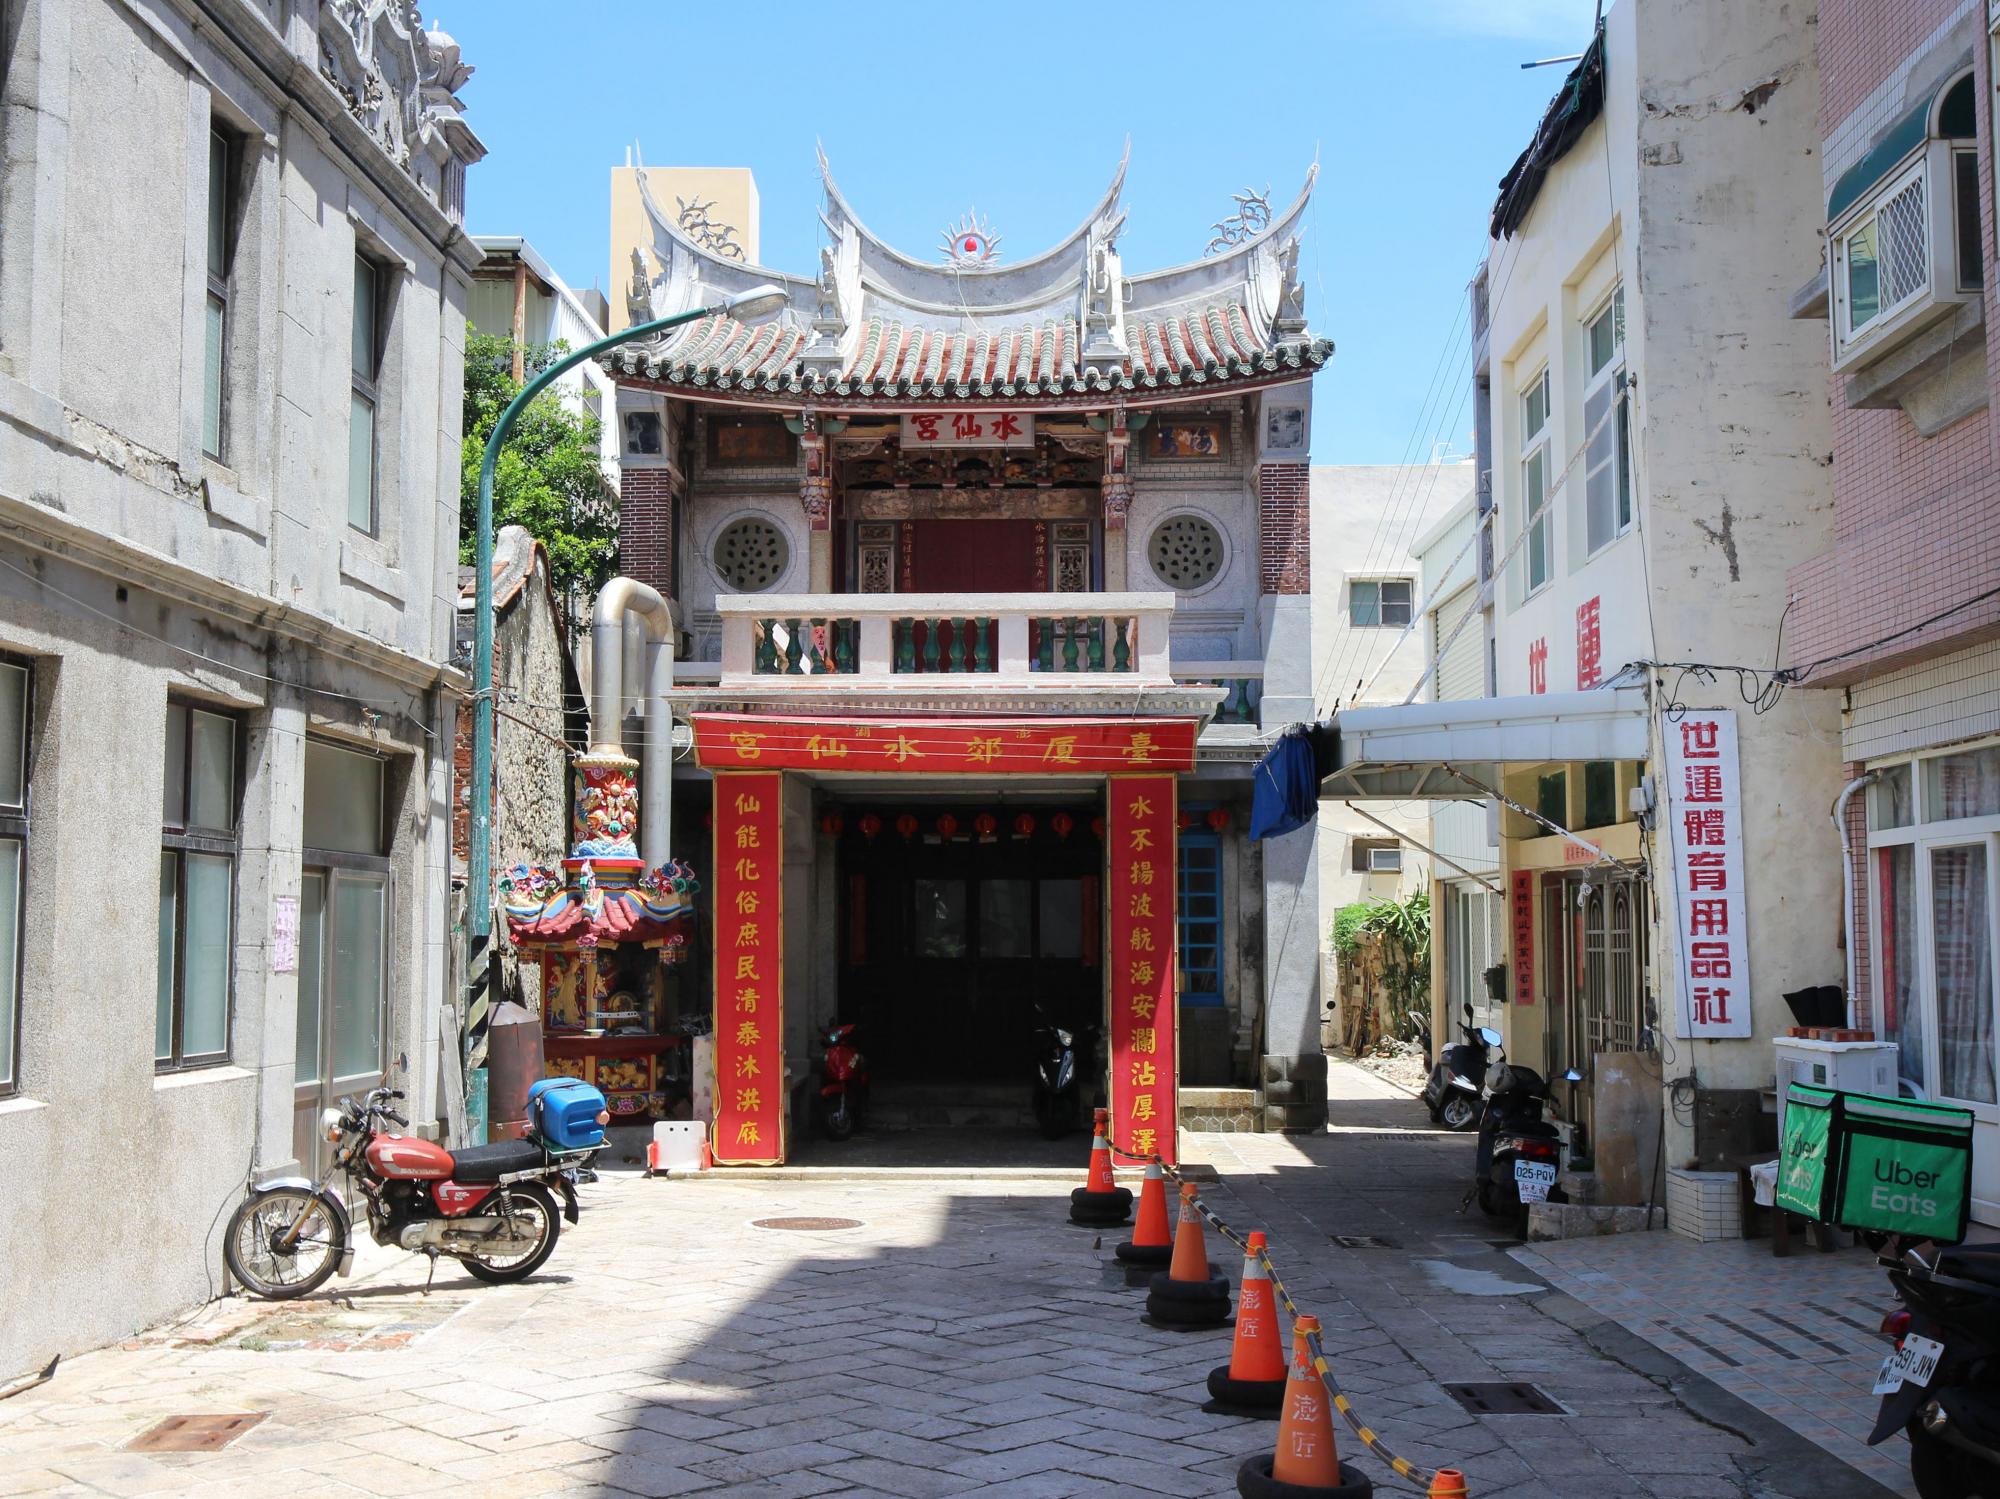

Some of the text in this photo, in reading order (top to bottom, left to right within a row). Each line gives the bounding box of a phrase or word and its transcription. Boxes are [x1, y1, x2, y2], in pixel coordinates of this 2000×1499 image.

[1680, 721, 1732, 1024] 世運體育用品社
[1874, 1158, 1940, 1189] Uber
[1871, 1186, 1937, 1217] Eats
[1895, 1347, 1936, 1380] 591-JVN
